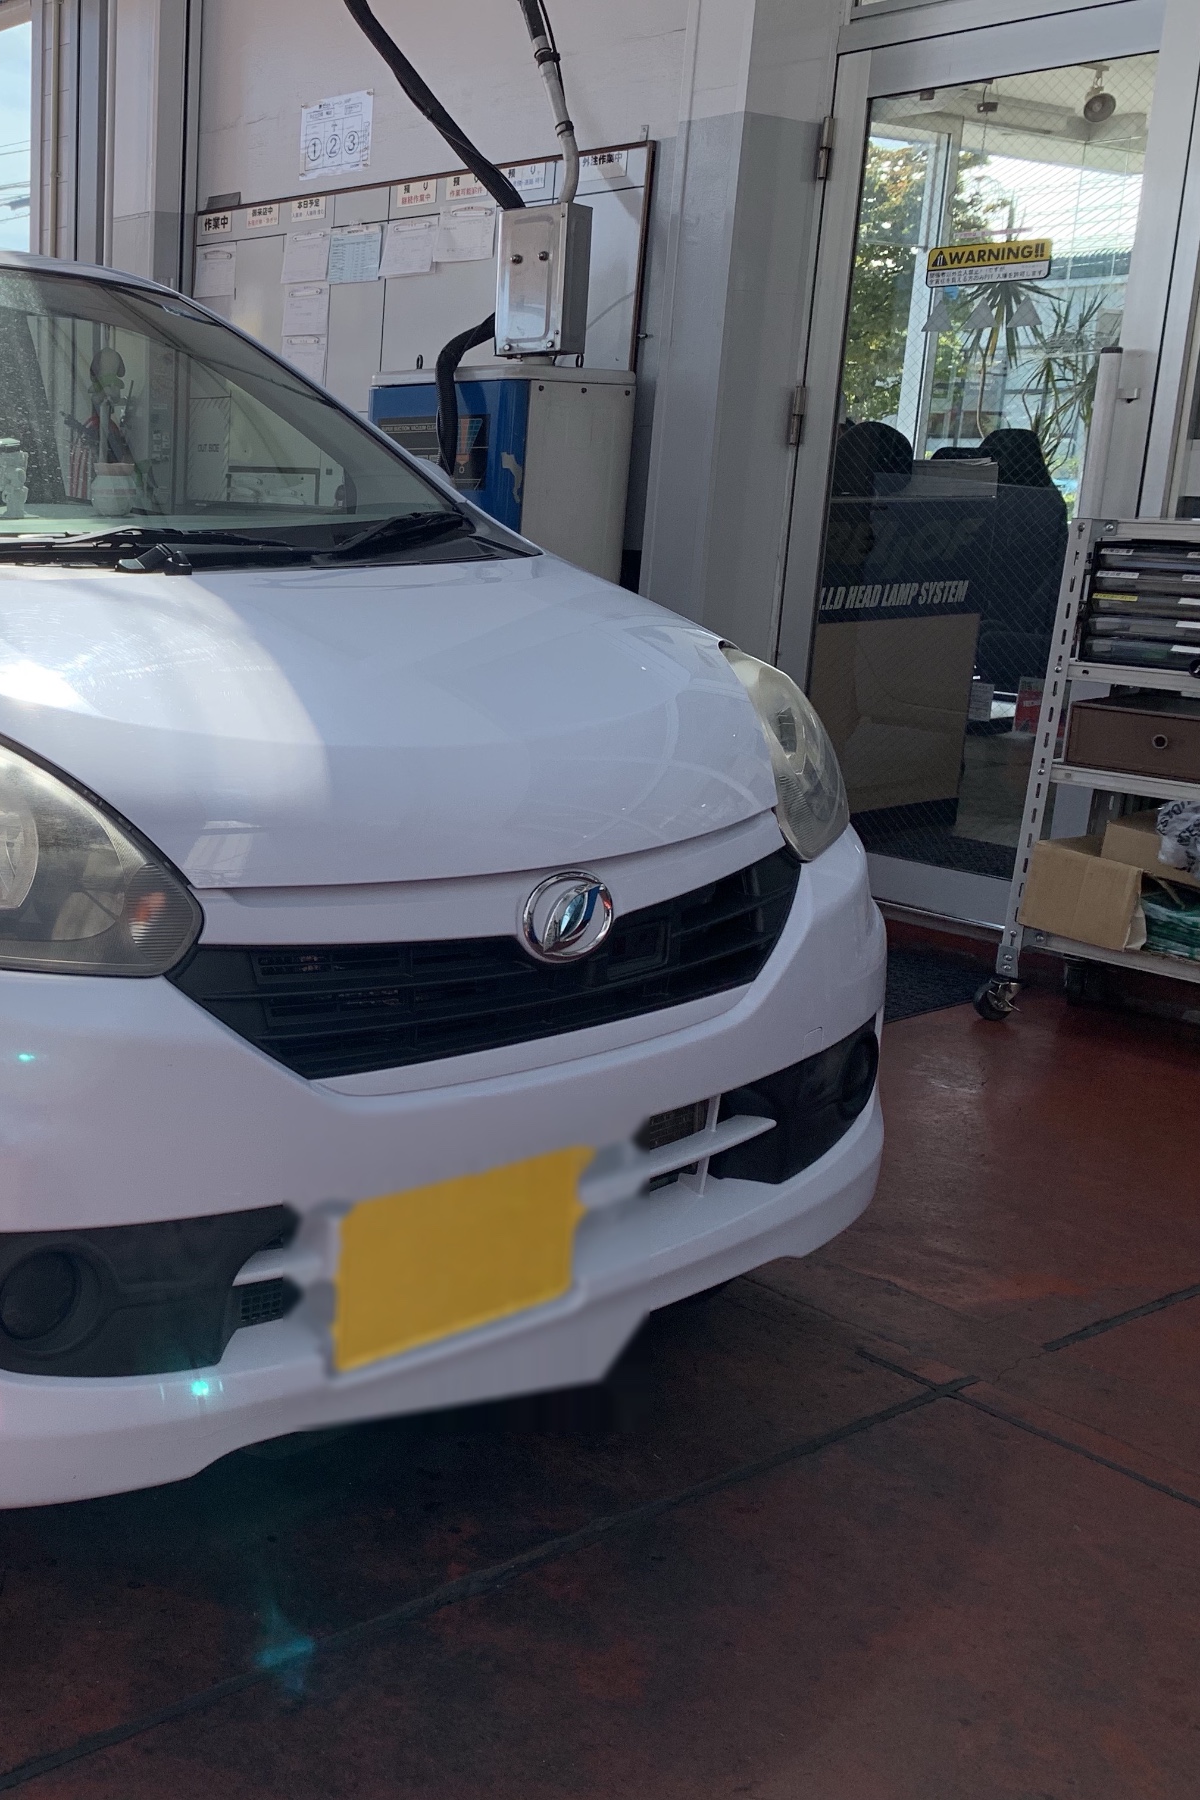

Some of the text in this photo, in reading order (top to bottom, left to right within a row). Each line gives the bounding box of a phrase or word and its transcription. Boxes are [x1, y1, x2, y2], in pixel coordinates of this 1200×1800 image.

[582, 152, 623, 167] 外注作業中
[204, 215, 229, 231] 作業中
[949, 242, 1046, 265] WARNING!!
[845, 584, 882, 609] HEAD
[881, 582, 919, 607] LAMP
[918, 580, 969, 605] SYSTEM
